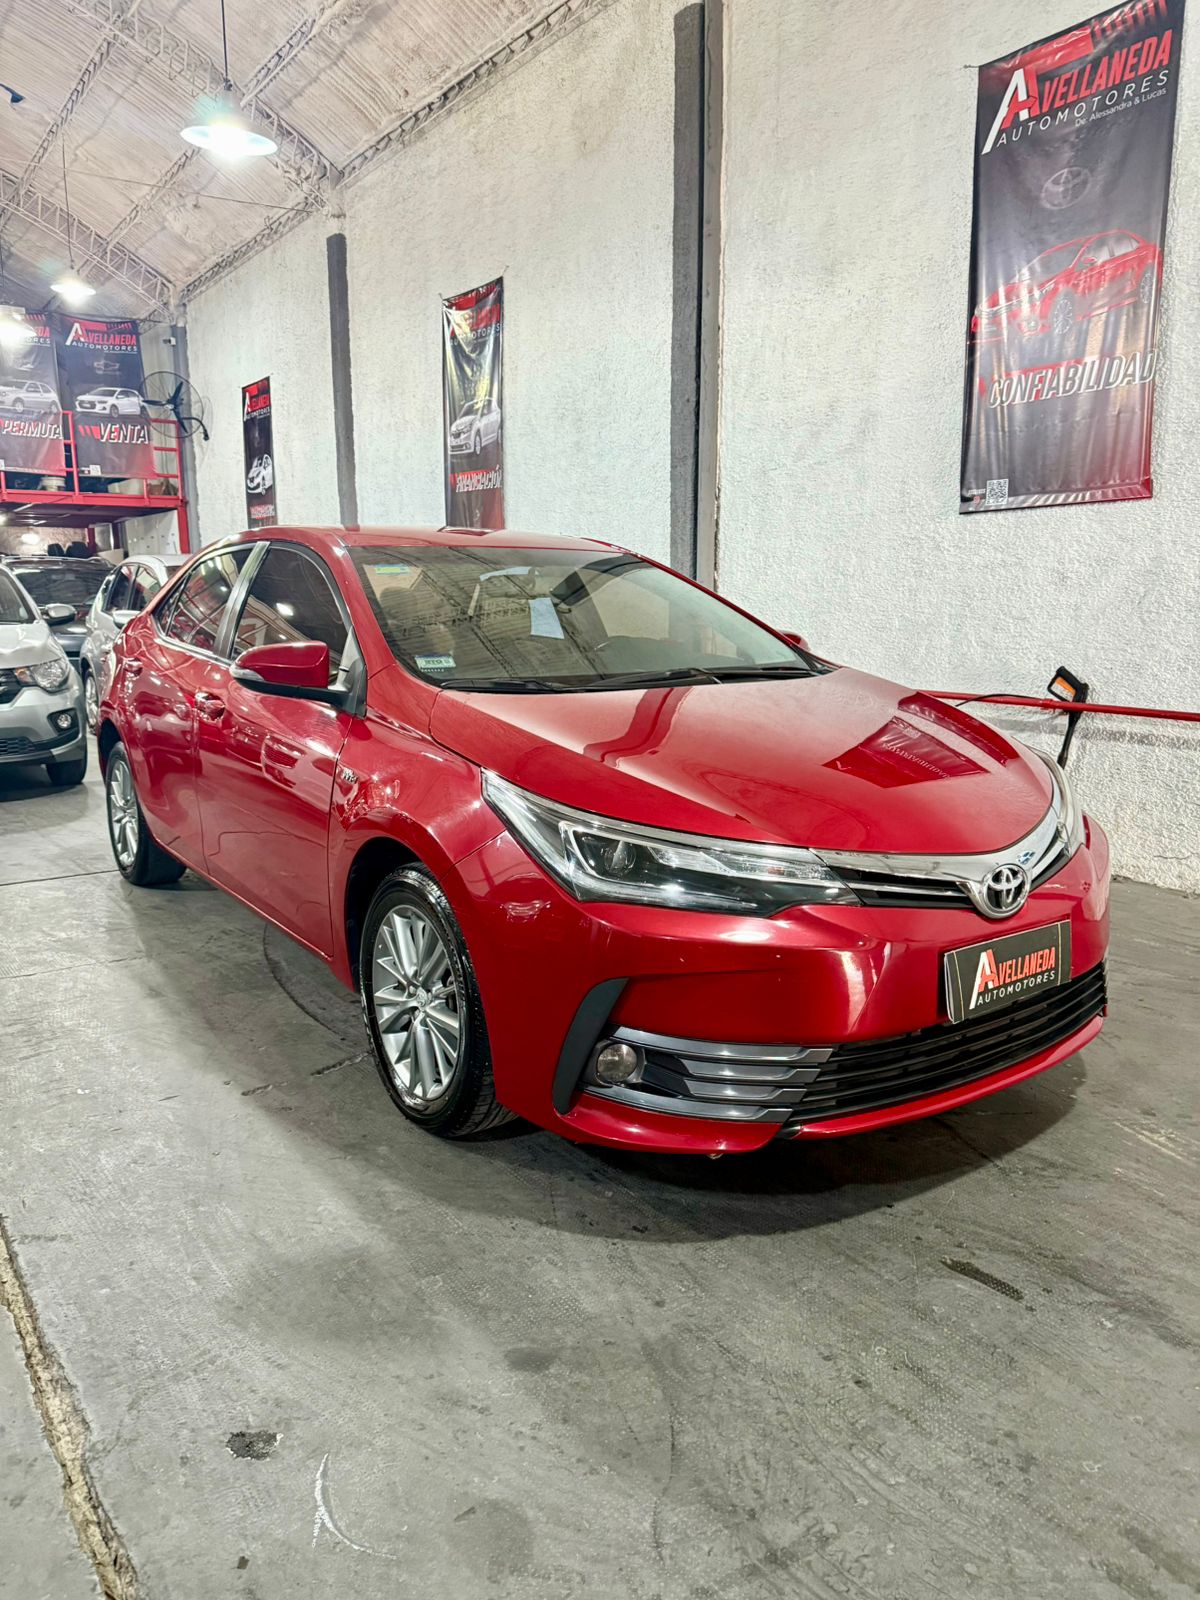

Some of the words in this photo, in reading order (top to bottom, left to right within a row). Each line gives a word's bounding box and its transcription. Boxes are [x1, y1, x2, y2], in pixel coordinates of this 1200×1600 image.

[980, 29, 1173, 155] AVELLANEDA
[996, 70, 1169, 148] AUTOMOTORES
[1090, 100, 1132, 122] Alessandra
[1134, 96, 1141, 106] &
[1142, 88, 1167, 103] Lucas
[65, 322, 137, 346] AVELLANEDA
[72, 340, 138, 352] AUTOMOTORES
[988, 351, 1158, 409] CONFIABILIDAD
[2, 419, 64, 440] PERMUTA
[100, 422, 150, 445] VENTA
[969, 946, 1056, 1010] AVELLANEDA
[977, 970, 1057, 1006] AUTOMOTORES
